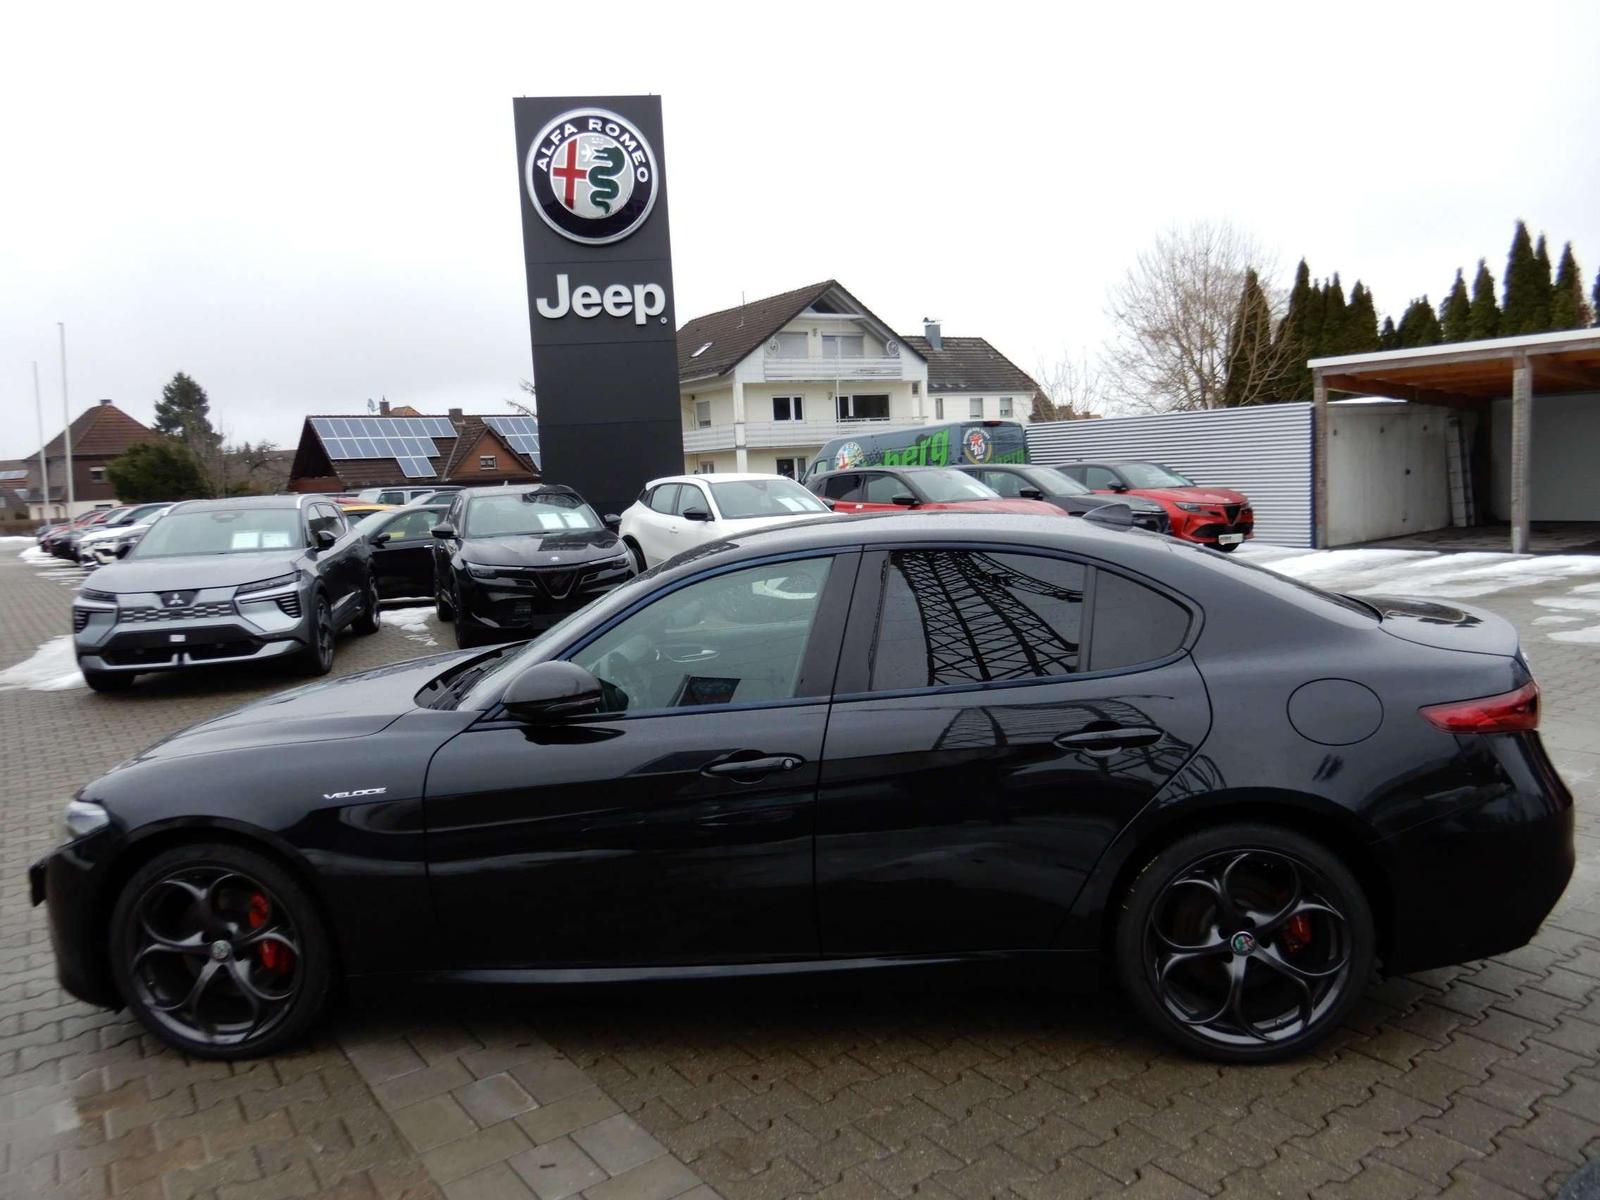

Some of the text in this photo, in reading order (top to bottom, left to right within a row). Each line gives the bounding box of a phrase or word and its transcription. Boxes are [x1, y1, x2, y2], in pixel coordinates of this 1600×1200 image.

[537, 118, 649, 183] ALFA ROMEO
[536, 273, 666, 326] Jeep
[323, 787, 386, 799] VELOCE
